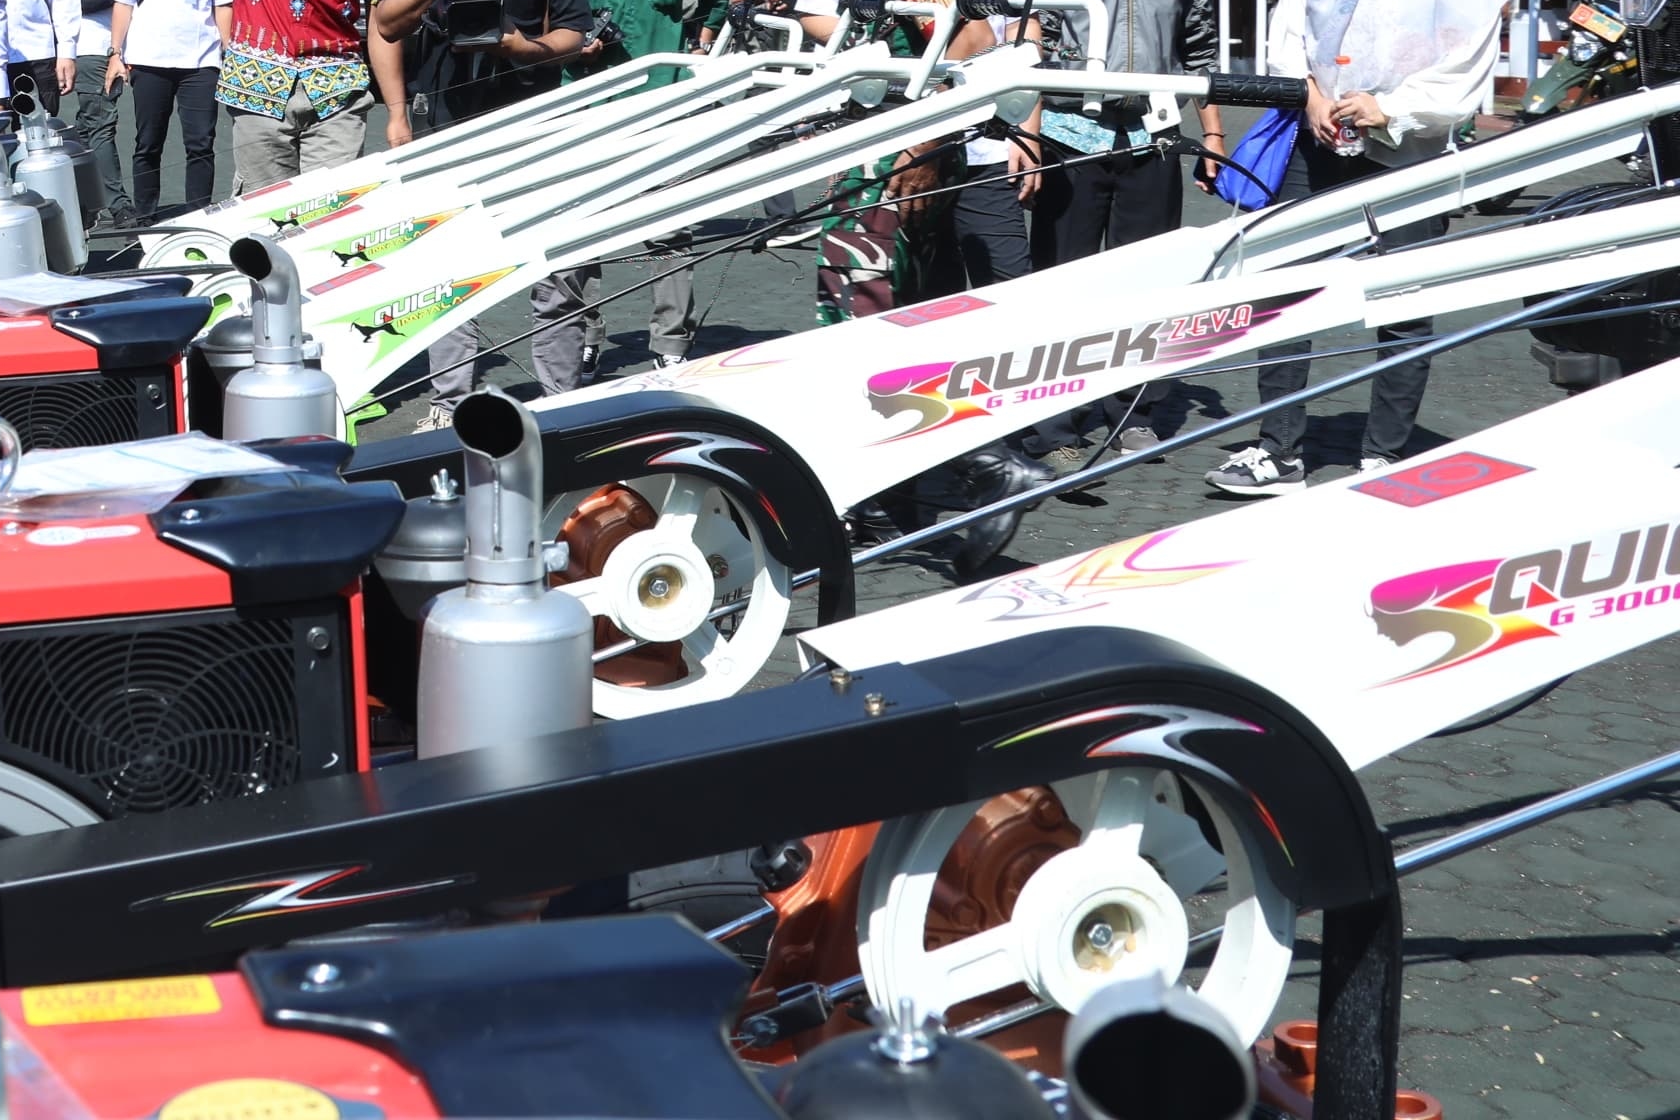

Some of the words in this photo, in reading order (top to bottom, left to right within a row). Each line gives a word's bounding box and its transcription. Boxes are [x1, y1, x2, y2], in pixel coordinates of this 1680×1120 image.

[285, 190, 339, 221] QUICK
[350, 217, 415, 254] QUICK
[374, 278, 454, 327] QUICK
[945, 319, 1167, 399] QUICK
[1167, 303, 1254, 342] ZEVA
[985, 394, 1004, 409] G
[1012, 378, 1086, 405] 3000
[1488, 520, 1680, 616] QUI
[1549, 605, 1576, 627] G
